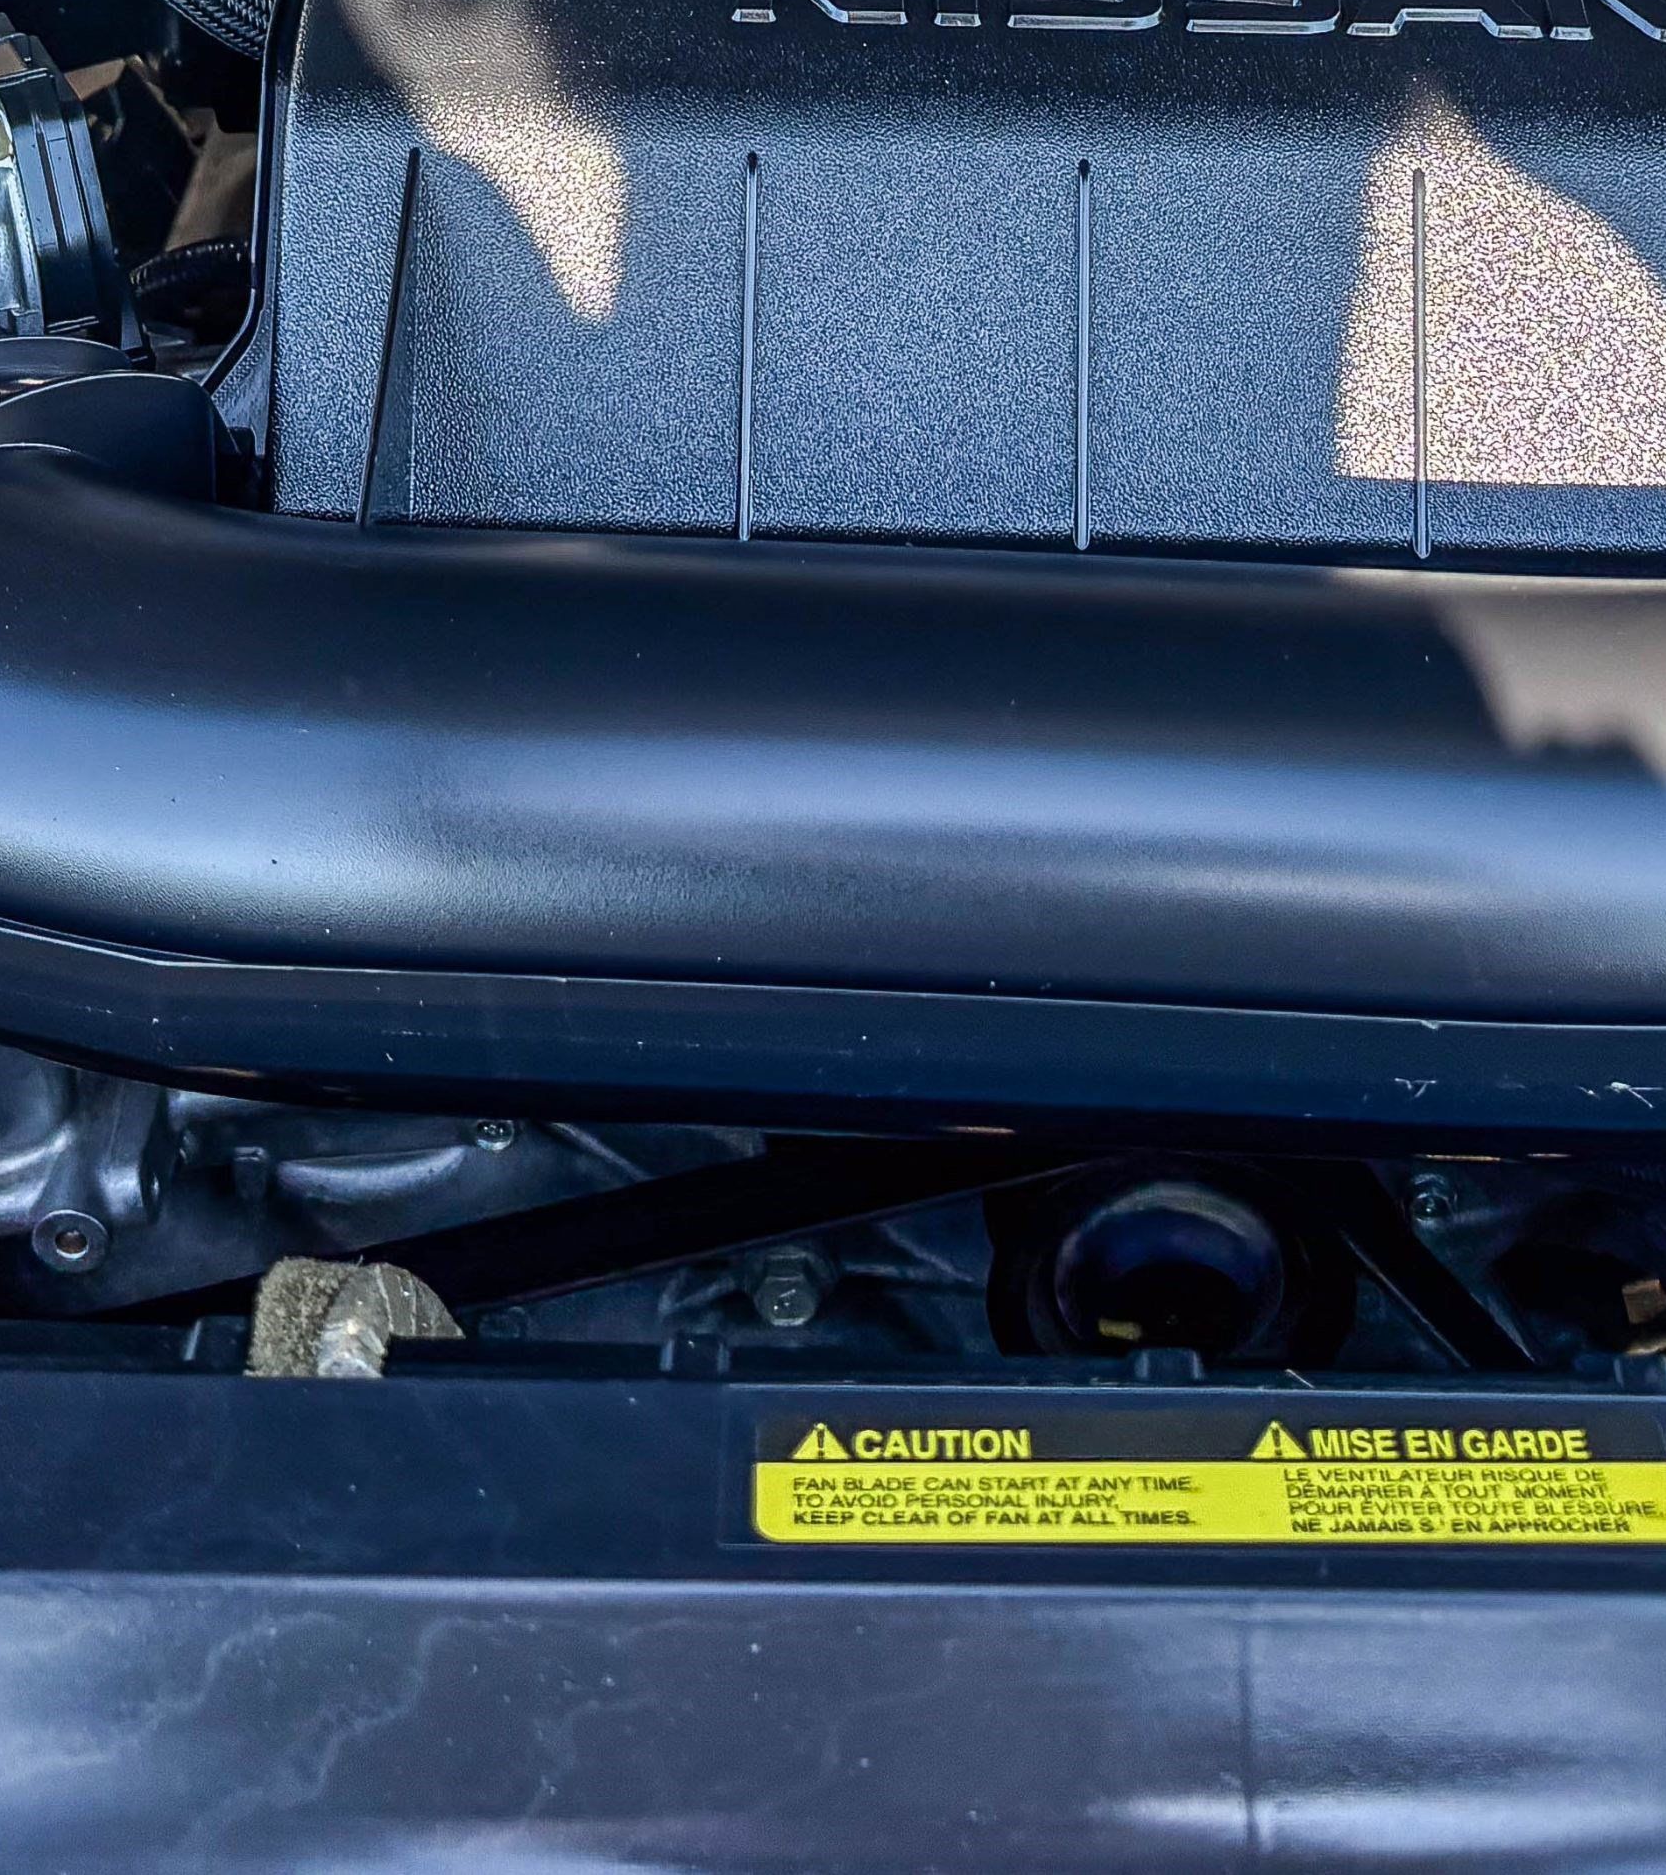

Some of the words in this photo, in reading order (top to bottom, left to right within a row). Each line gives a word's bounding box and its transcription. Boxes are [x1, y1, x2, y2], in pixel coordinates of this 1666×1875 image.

[853, 1428, 1031, 1460] CAUTION
[1310, 1428, 1399, 1460] MISE
[1404, 1428, 1457, 1460] EN
[1462, 1428, 1590, 1460] GARDE
[793, 1476, 836, 1491] FAN
[842, 1476, 917, 1491] BLADE
[925, 1476, 973, 1491] CAN
[977, 1476, 1049, 1491] START
[1055, 1476, 1083, 1491] AT
[1087, 1476, 1132, 1491] ANY
[1283, 1468, 1309, 1483] LE
[1316, 1468, 1473, 1483] VENTILATEUR
[1482, 1468, 1568, 1483] RISQUE
[1575, 1468, 1606, 1483] DE
[1286, 1483, 1415, 1499] DÉMARRER
[1444, 1483, 1501, 1499] TOUT
[794, 1493, 823, 1509] TO
[829, 1493, 899, 1509] AVOID
[905, 1493, 1027, 1509] PERSONAL
[1289, 1500, 1352, 1518] POUR
[1360, 1500, 1444, 1518] ÉVITER
[1450, 1500, 1527, 1518] TOUTE
[793, 1510, 854, 1526] KEEP
[861, 1510, 940, 1526] CLEAR
[948, 1510, 978, 1526] OF
[985, 1510, 1032, 1526] FAN
[1036, 1510, 1064, 1526] AT
[1069, 1510, 1115, 1526] ALL
[1291, 1517, 1322, 1534] NE
[1329, 1517, 1409, 1534] JAMAIS
[1451, 1517, 1482, 1534] EN
[1488, 1517, 1632, 1534] APPROCHER
